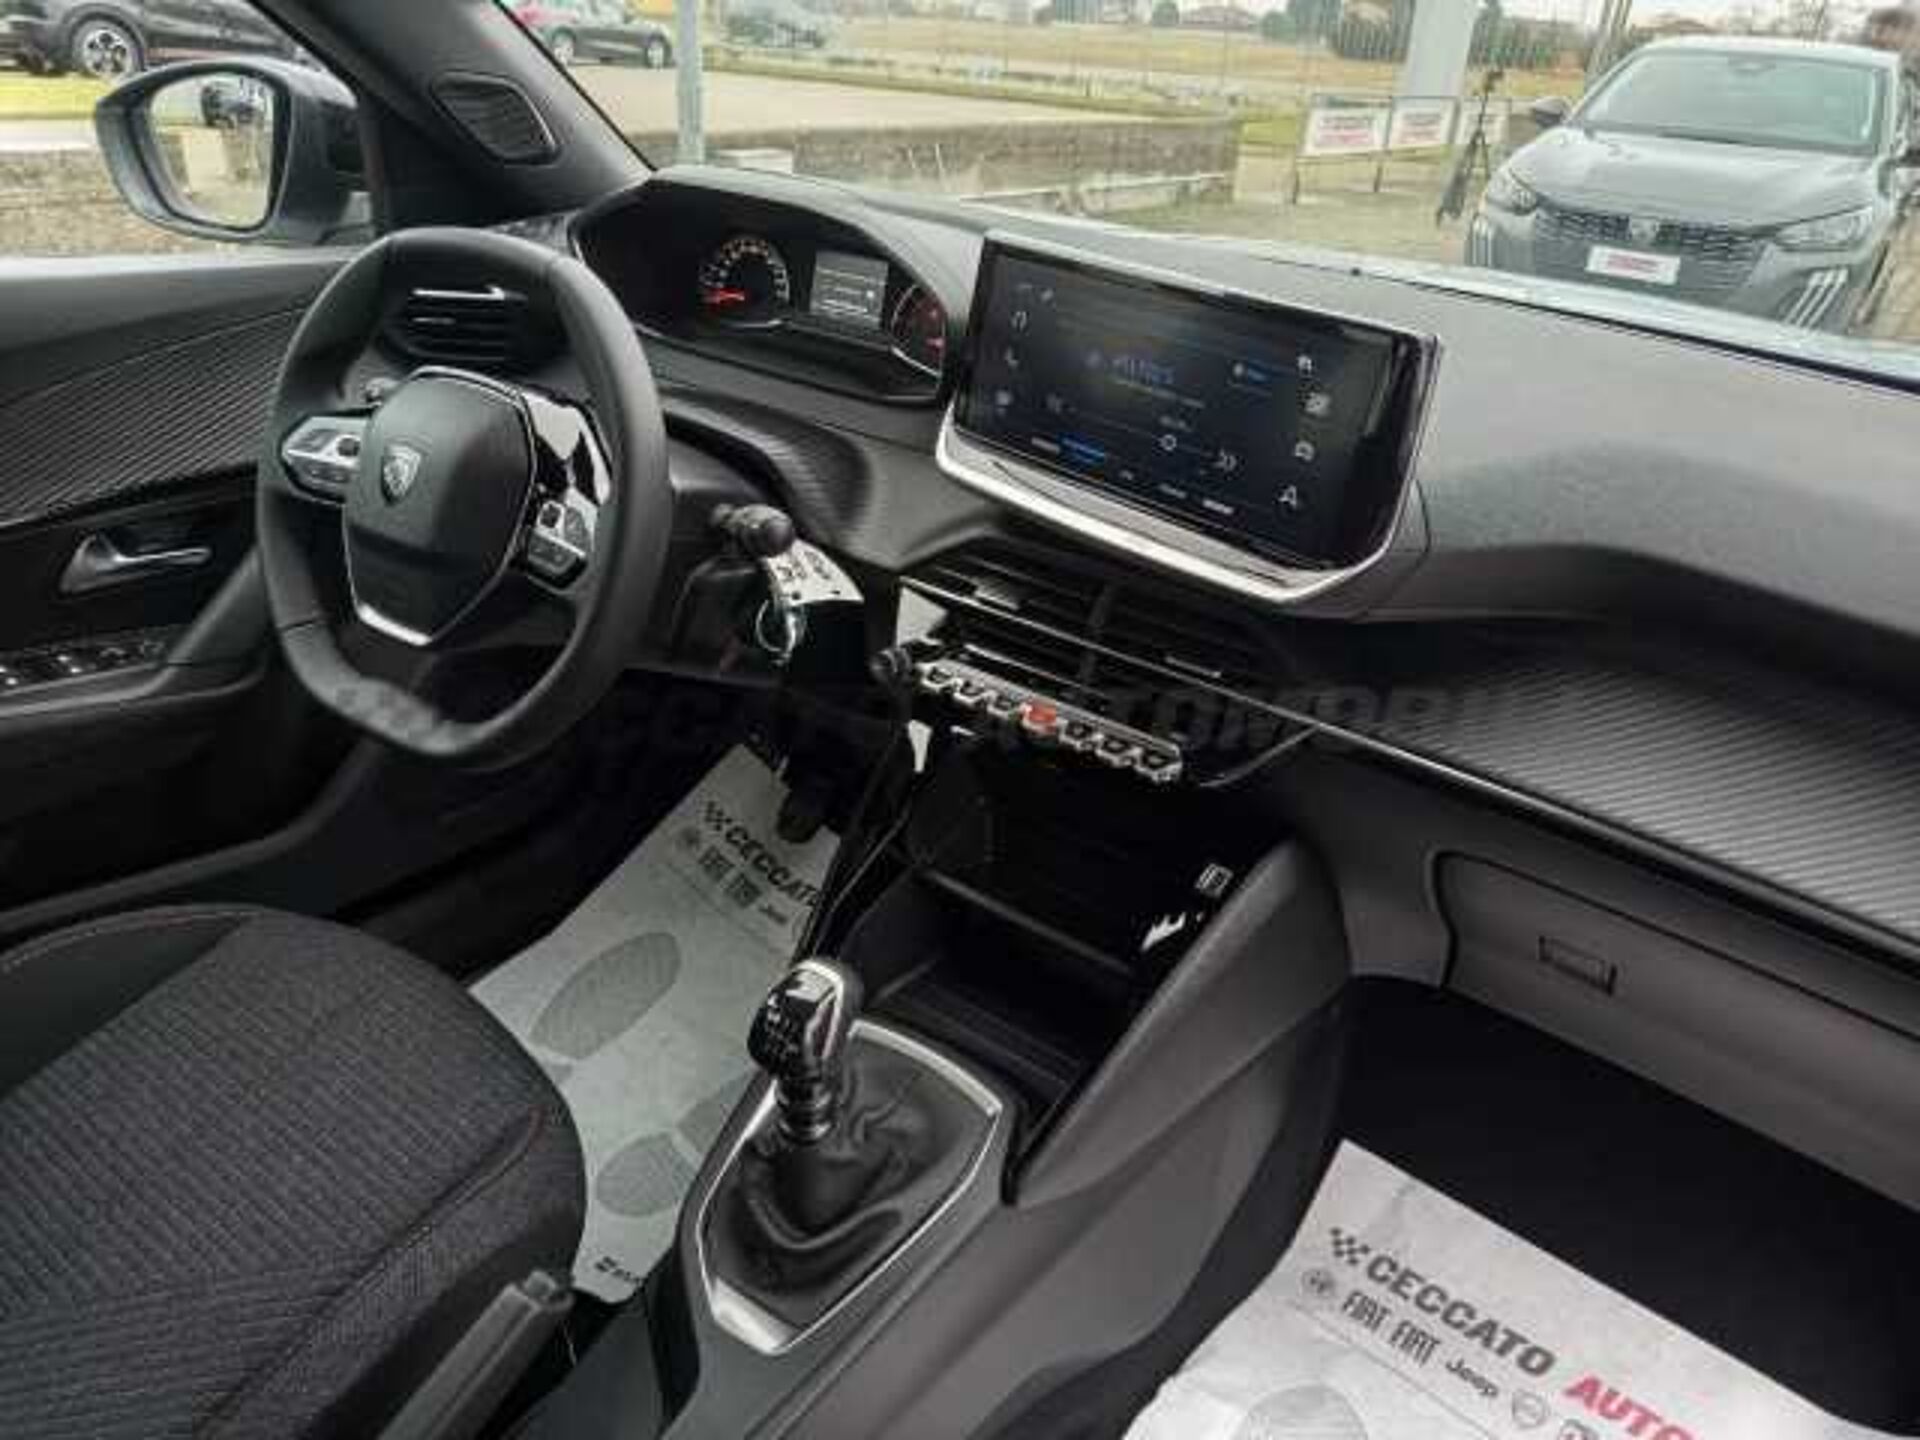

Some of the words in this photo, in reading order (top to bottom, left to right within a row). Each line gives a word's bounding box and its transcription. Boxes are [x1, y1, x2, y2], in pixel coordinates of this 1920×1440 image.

[1343, 1290, 1391, 1333] FIAT
[1391, 1320, 1441, 1367] FIAT
[1446, 1359, 1499, 1397] Jeep
[1367, 1255, 1556, 1377] CECCATO
